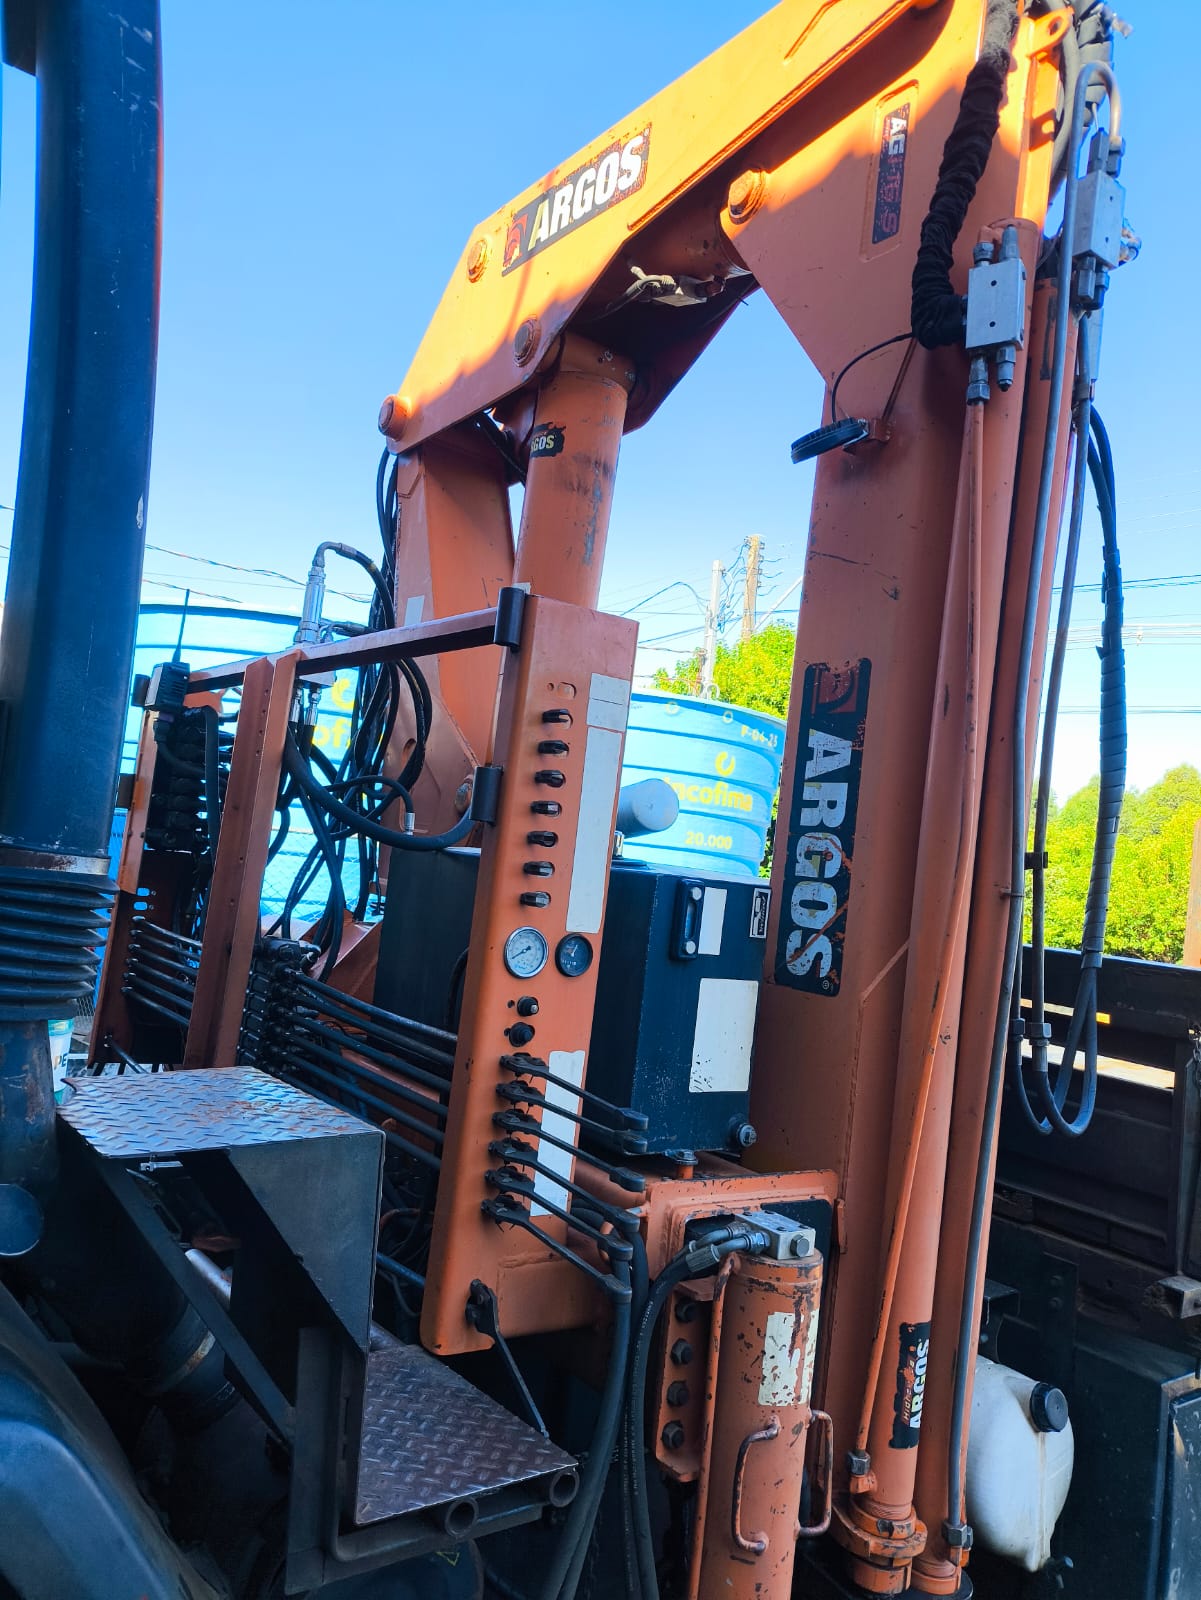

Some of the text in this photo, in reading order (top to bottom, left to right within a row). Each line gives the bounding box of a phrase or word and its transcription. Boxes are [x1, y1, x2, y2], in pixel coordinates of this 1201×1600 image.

[527, 135, 644, 251] ARGOS
[684, 831, 733, 850] 20.000
[786, 728, 853, 978] ARGOS
